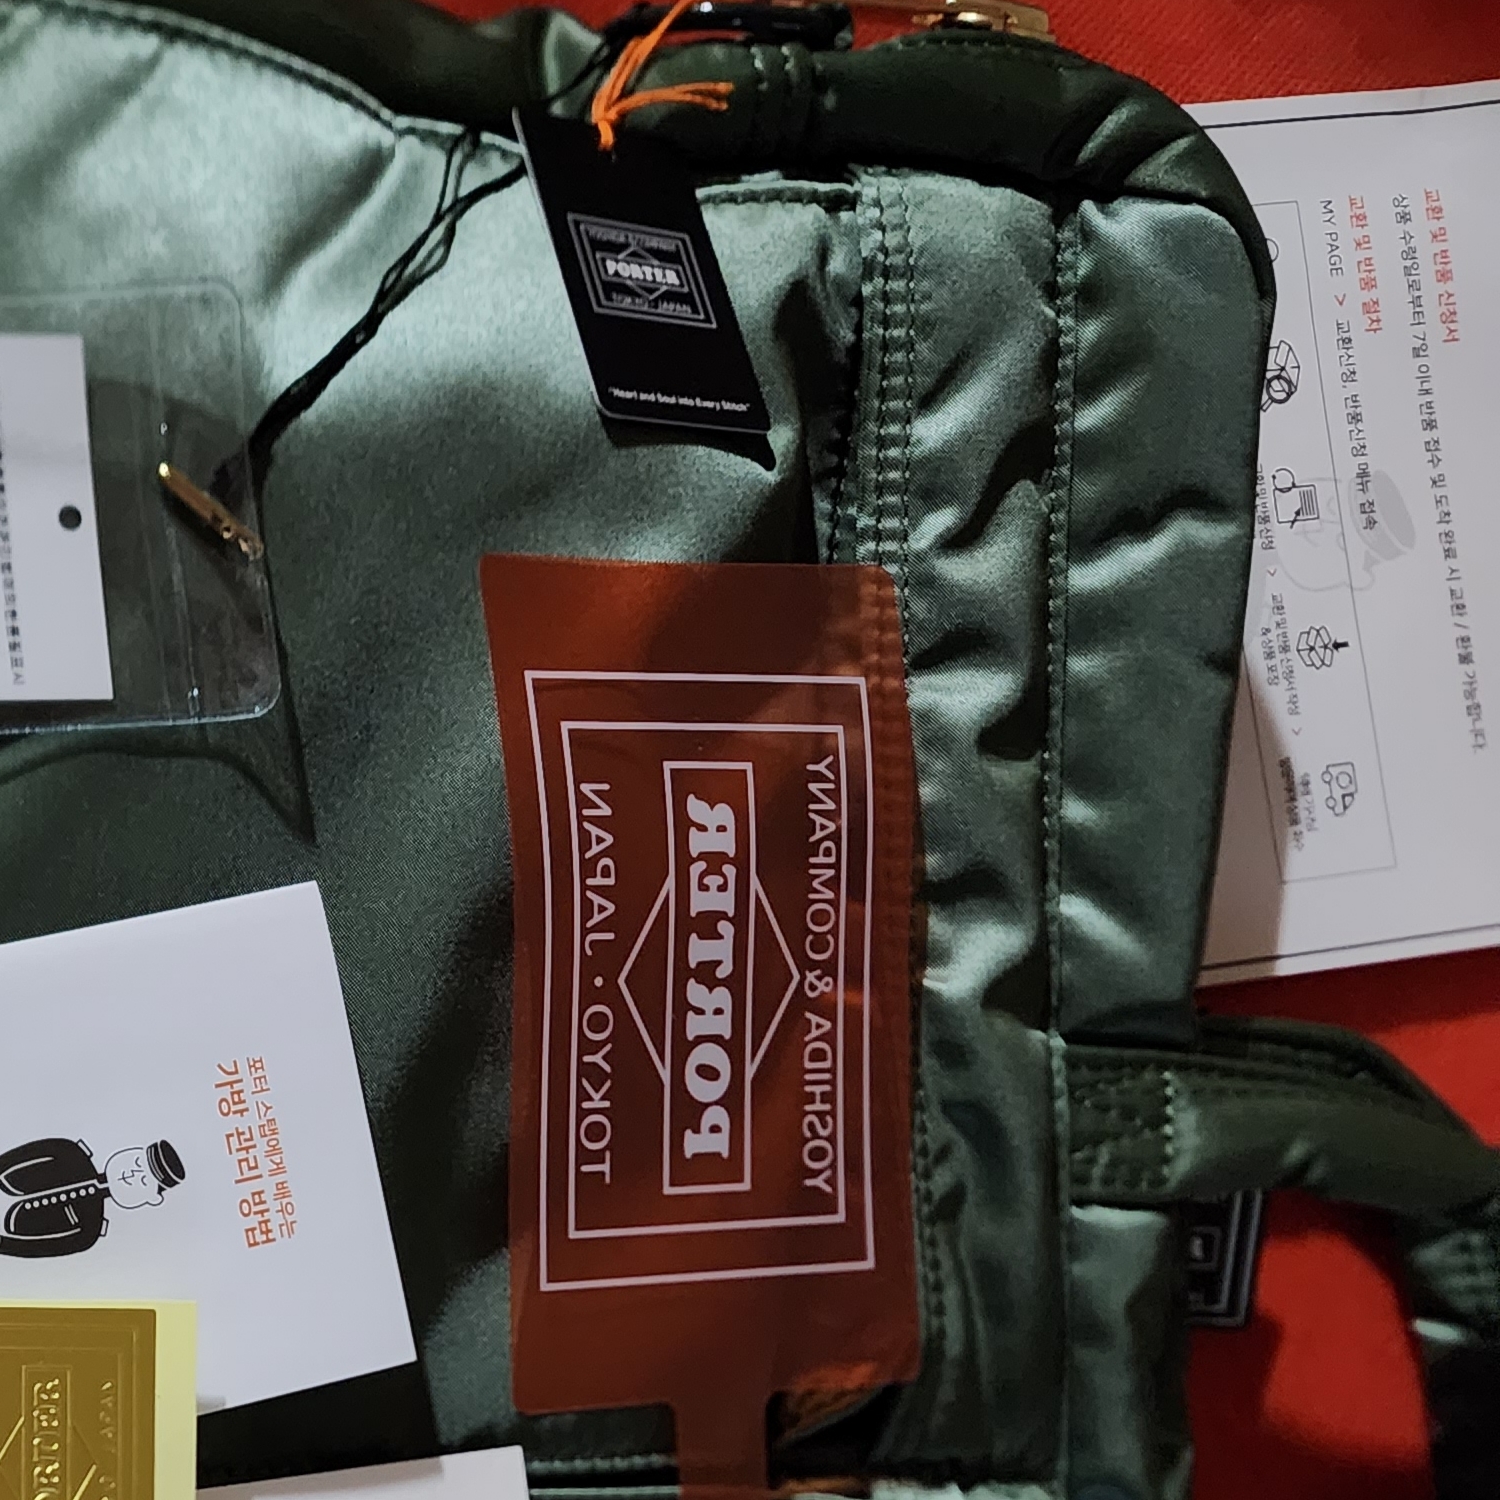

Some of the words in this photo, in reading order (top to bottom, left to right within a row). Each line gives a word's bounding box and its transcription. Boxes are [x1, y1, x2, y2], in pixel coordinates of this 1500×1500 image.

[1320, 200, 1336, 225] MY
[1348, 195, 1368, 229] 교환
[1392, 194, 1412, 225] 상품
[1424, 189, 1444, 221] 교환
[1354, 235, 1372, 251] 및
[1430, 227, 1448, 244] 및
[1325, 232, 1343, 278] PAGE
[1433, 249, 1453, 284] 반품
[606, 259, 680, 286] PORTER
[1357, 257, 1377, 292] 반품
[1399, 230, 1426, 326] 수령일로부터
[1361, 298, 1382, 334] 절차
[1438, 290, 1460, 343] 신청서
[1336, 319, 1358, 389] 교환신청,
[1412, 331, 1429, 359] 7일
[1415, 364, 1434, 396] 이내
[1344, 394, 1368, 458] 반품신청
[1419, 401, 1438, 431] 반품
[1424, 437, 1442, 469] 접수
[1355, 462, 1371, 494] 메뉴
[1429, 473, 1446, 489] 및
[1359, 499, 1378, 530] 접속
[1434, 494, 1451, 525] 도착
[1439, 529, 1457, 561] 완료
[1446, 566, 1461, 581] 시
[1449, 587, 1467, 617] 교환
[1456, 635, 1474, 665] 환불
[215, 1060, 250, 1117] 가방
[246, 1056, 270, 1095] 포터
[225, 1125, 263, 1184] 관리
[255, 1100, 287, 1177] 스탭에게
[239, 1190, 276, 1248] 방법
[272, 1181, 297, 1238] 배우는
